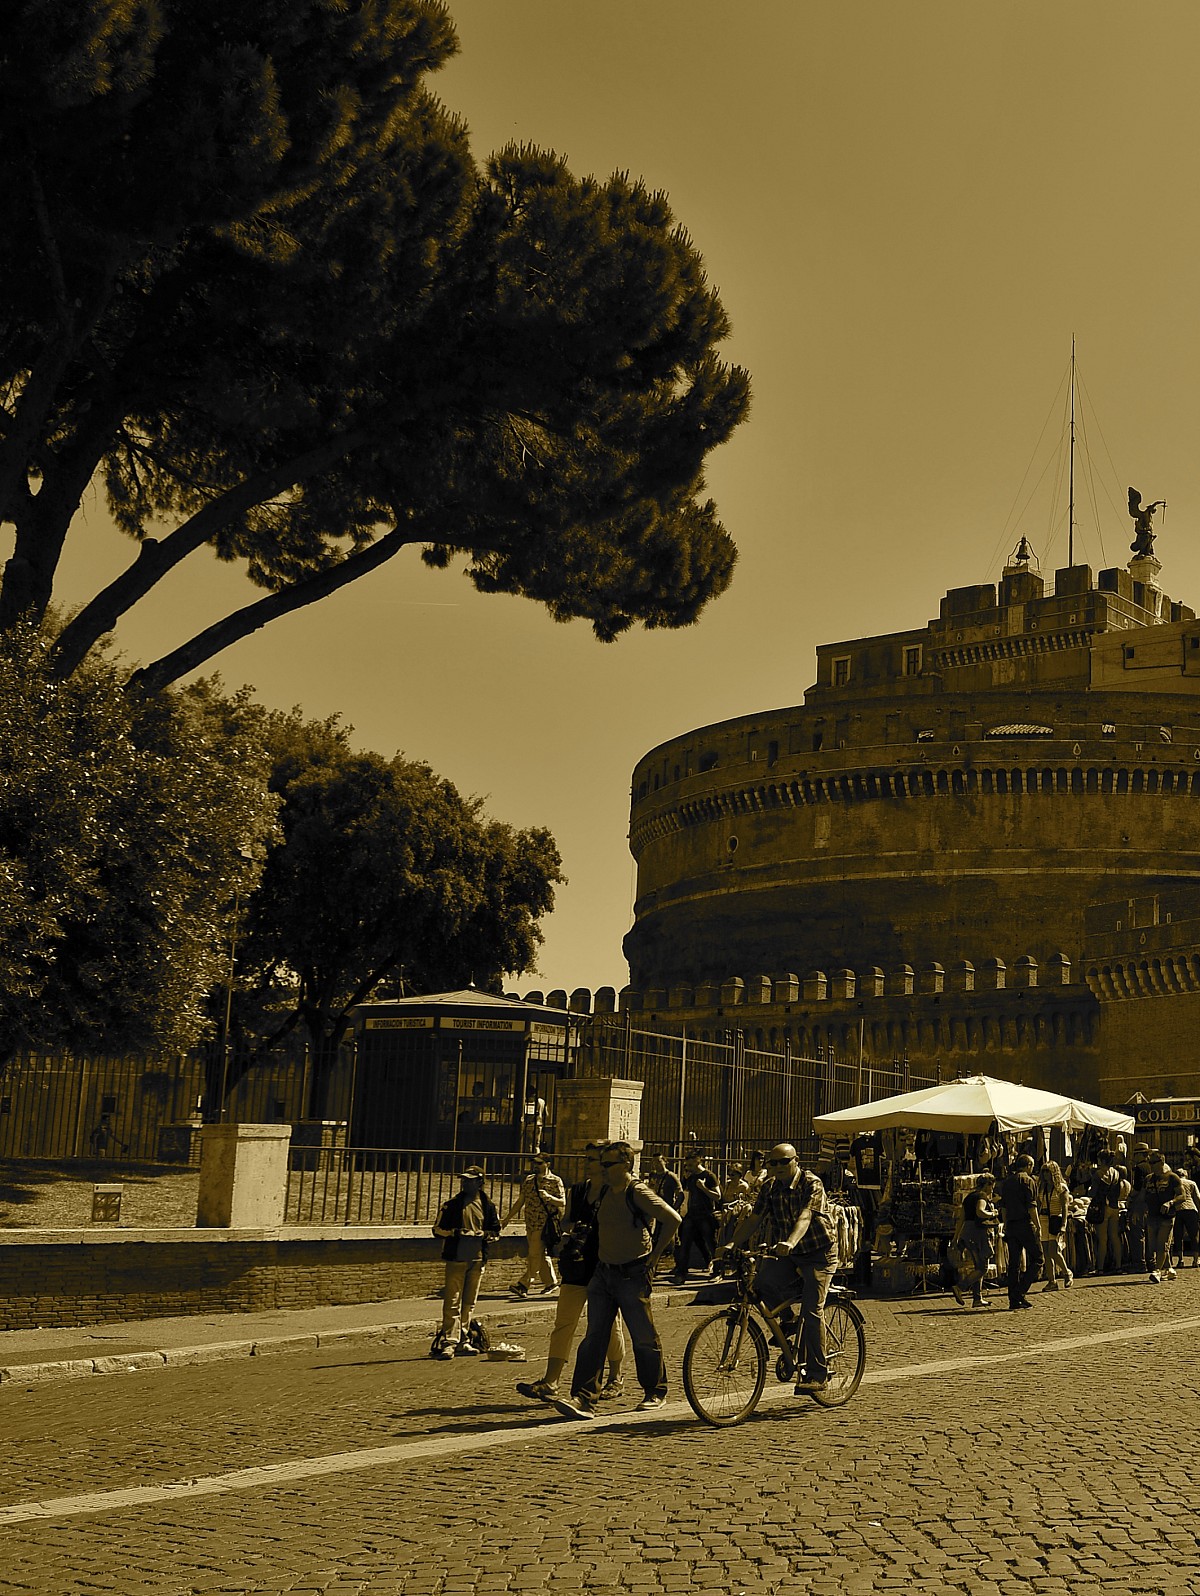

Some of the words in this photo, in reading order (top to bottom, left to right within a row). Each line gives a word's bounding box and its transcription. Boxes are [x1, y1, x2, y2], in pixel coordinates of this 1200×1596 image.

[453, 1019, 476, 1029] TOURIST
[476, 1020, 513, 1031] INFORMATION
[1137, 1108, 1180, 1122] COLD
